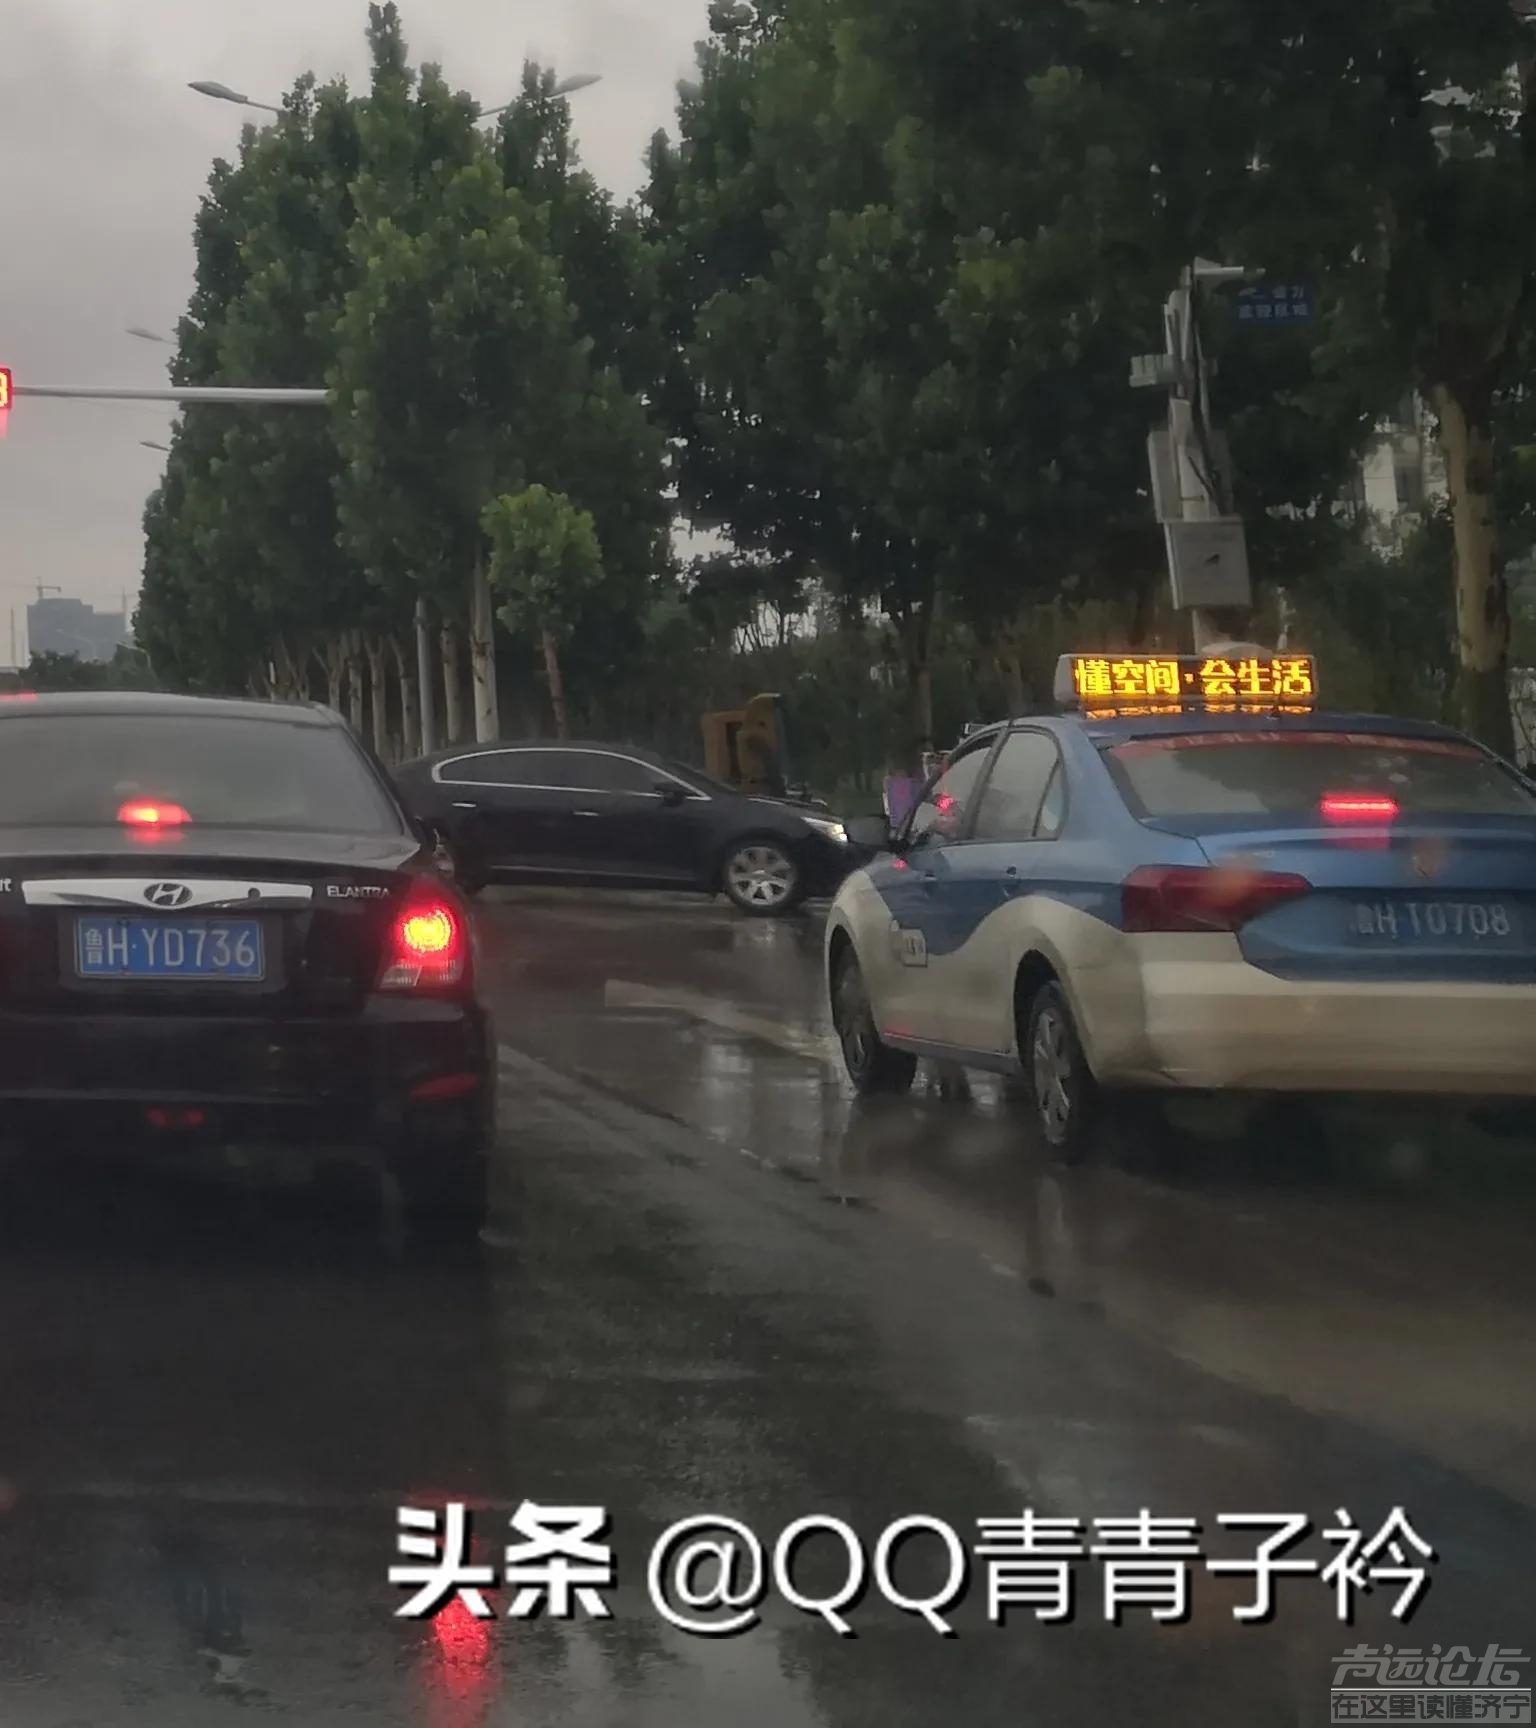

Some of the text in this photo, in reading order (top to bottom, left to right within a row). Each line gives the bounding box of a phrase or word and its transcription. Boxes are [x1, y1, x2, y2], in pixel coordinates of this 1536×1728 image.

[1075, 658, 1312, 695] 懂空间·会生活
[327, 884, 391, 898] ELANTRA
[85, 927, 256, 967] 鲁H·YD736
